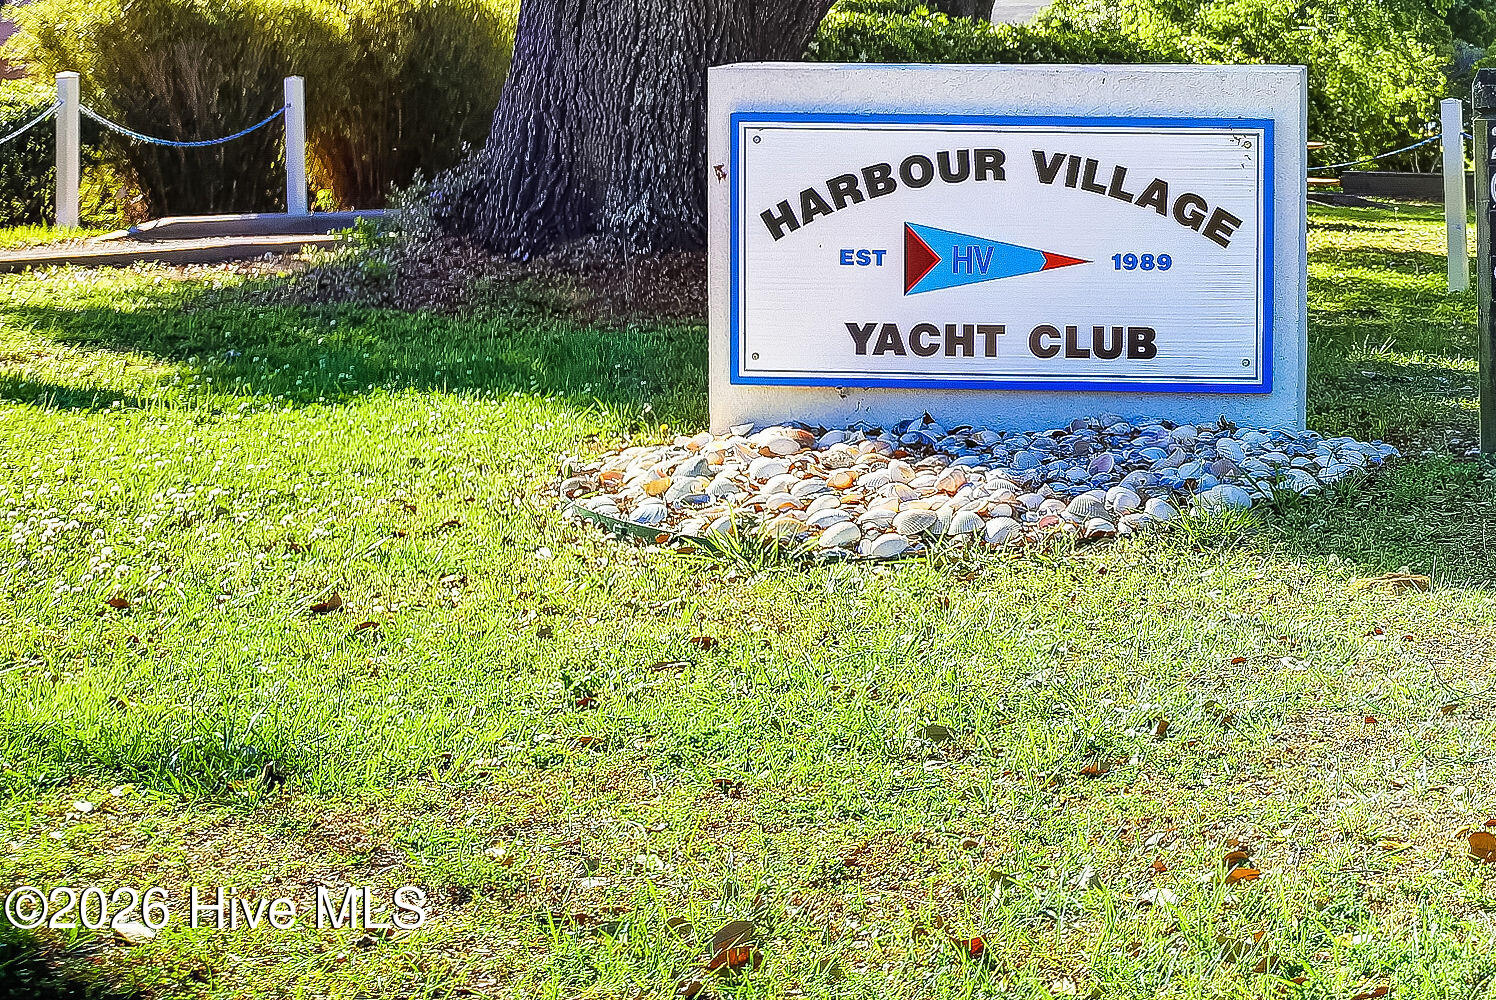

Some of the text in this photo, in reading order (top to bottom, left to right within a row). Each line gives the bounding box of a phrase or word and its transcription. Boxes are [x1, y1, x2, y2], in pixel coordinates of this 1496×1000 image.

[760, 148, 1243, 249] HARBOUR VILLAGE
[840, 249, 1173, 271] EST 1989
[952, 246, 994, 275] HV
[846, 322, 1158, 361] YACHT CLUB
